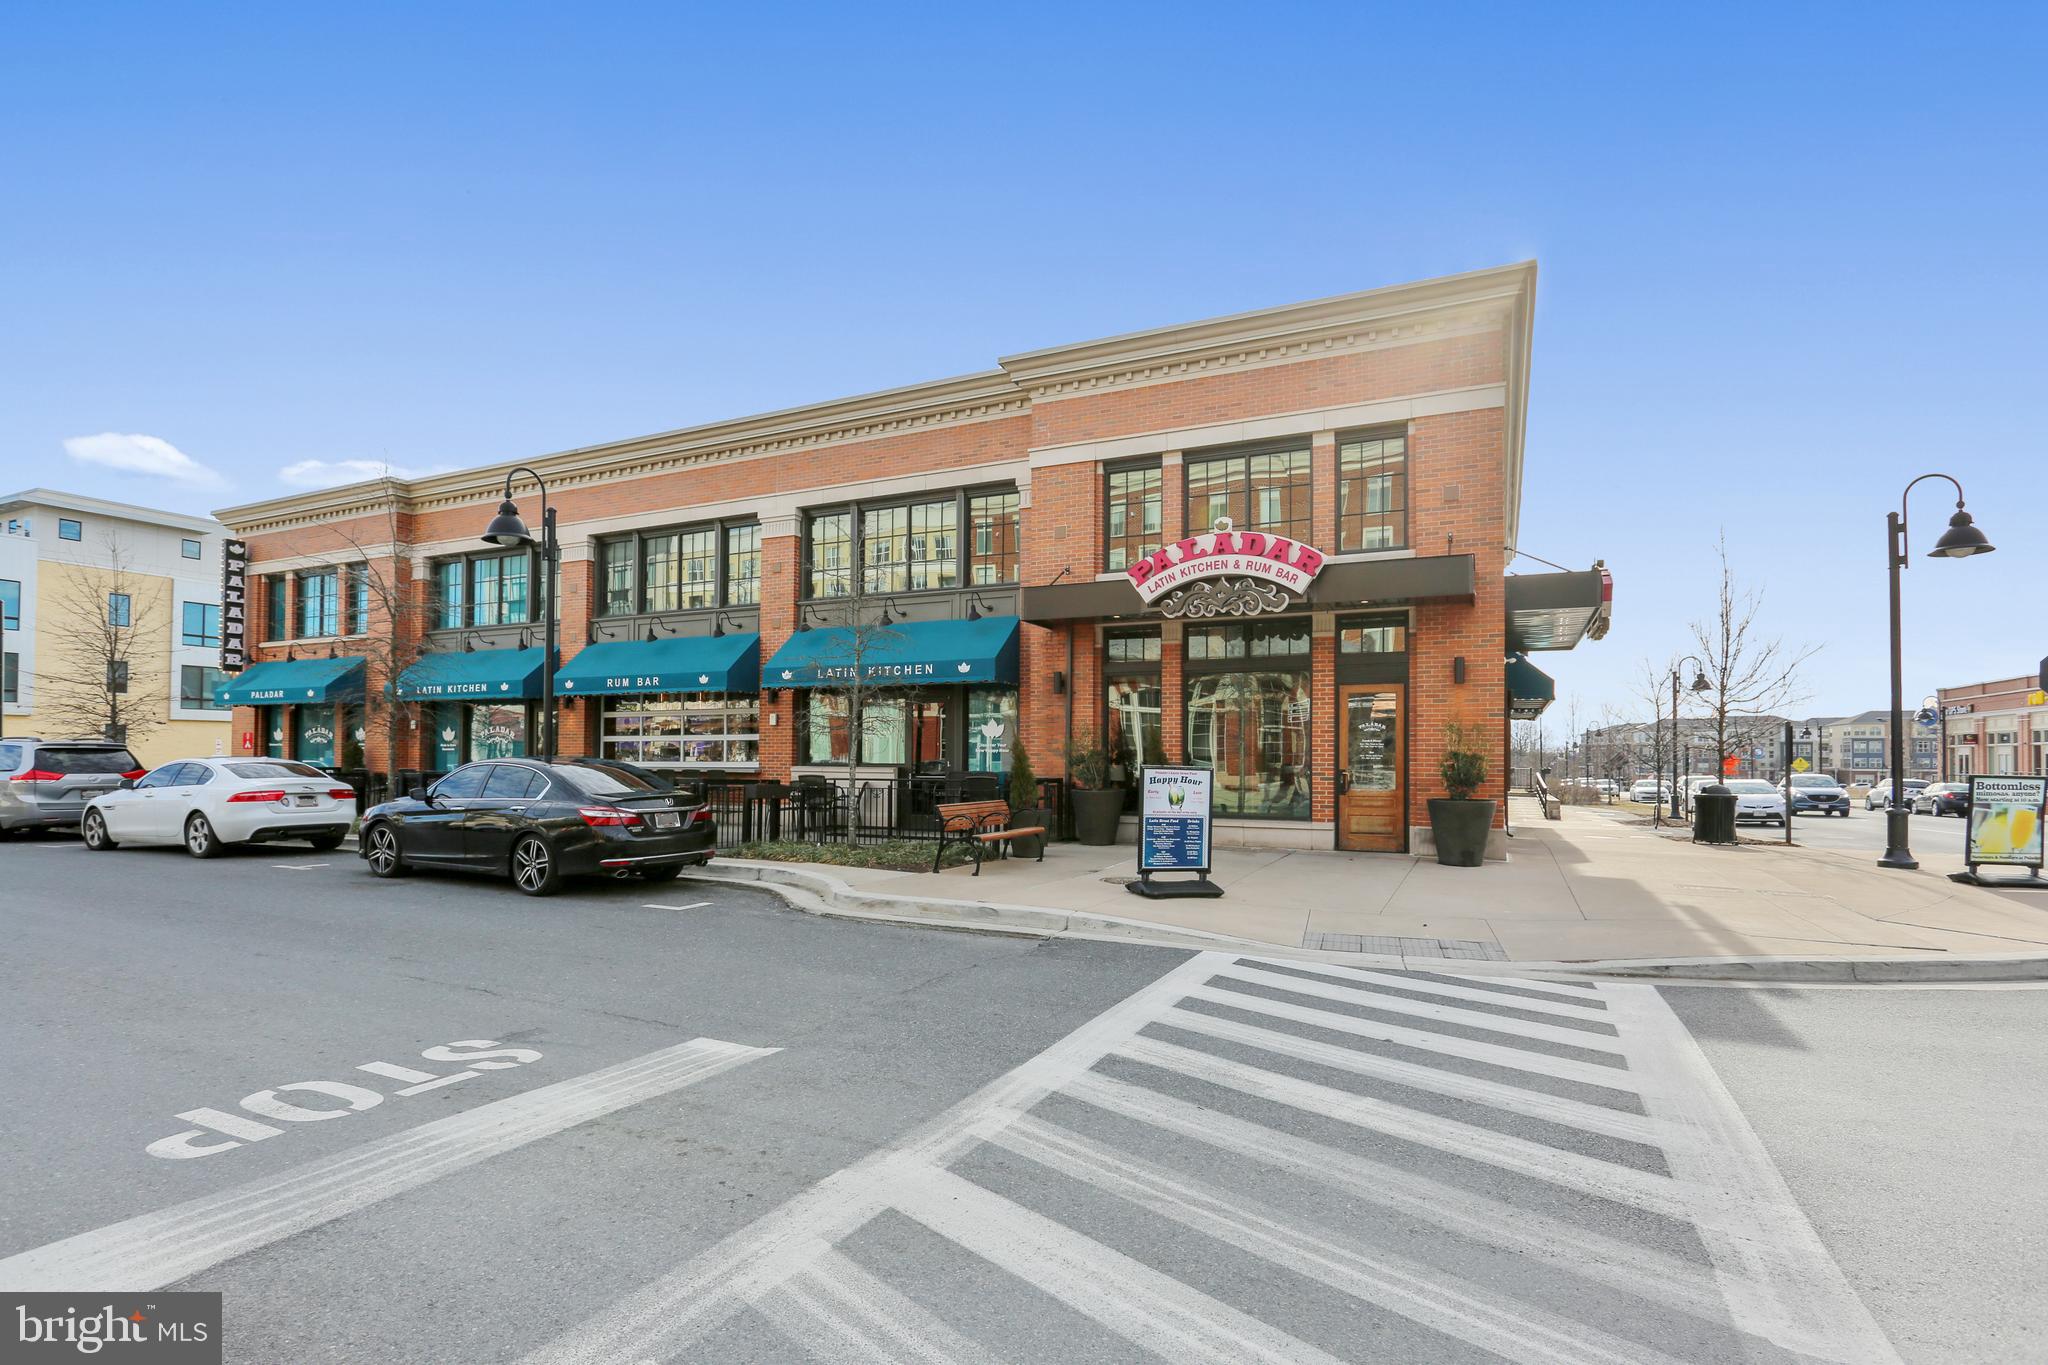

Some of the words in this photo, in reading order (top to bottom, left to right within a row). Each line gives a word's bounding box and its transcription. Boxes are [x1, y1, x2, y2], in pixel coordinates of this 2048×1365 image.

[1127, 532, 1323, 588] PALADAR
[1147, 572, 1177, 594] LATIN
[1179, 559, 1229, 579] KITCHEN
[1233, 559, 1241, 570] &
[1245, 560, 1272, 574] RUM
[1276, 567, 1300, 585] BAR
[224, 559, 245, 666] PALADAR
[817, 667, 856, 679] LATIN
[868, 663, 933, 677] KITCHEN
[607, 677, 629, 688] RUM
[637, 676, 659, 687] BAR
[250, 690, 284, 699] PALADAR
[416, 685, 442, 695] LATIN
[447, 683, 487, 694] KITCHEN
[304, 727, 333, 739] PALADAR
[480, 725, 516, 740] PALADAR
[1149, 776, 1179, 786] Happy
[1180, 775, 1203, 786] Hour
[1976, 781, 2041, 791] Bottomless
[145, 1039, 543, 1160] STOP
